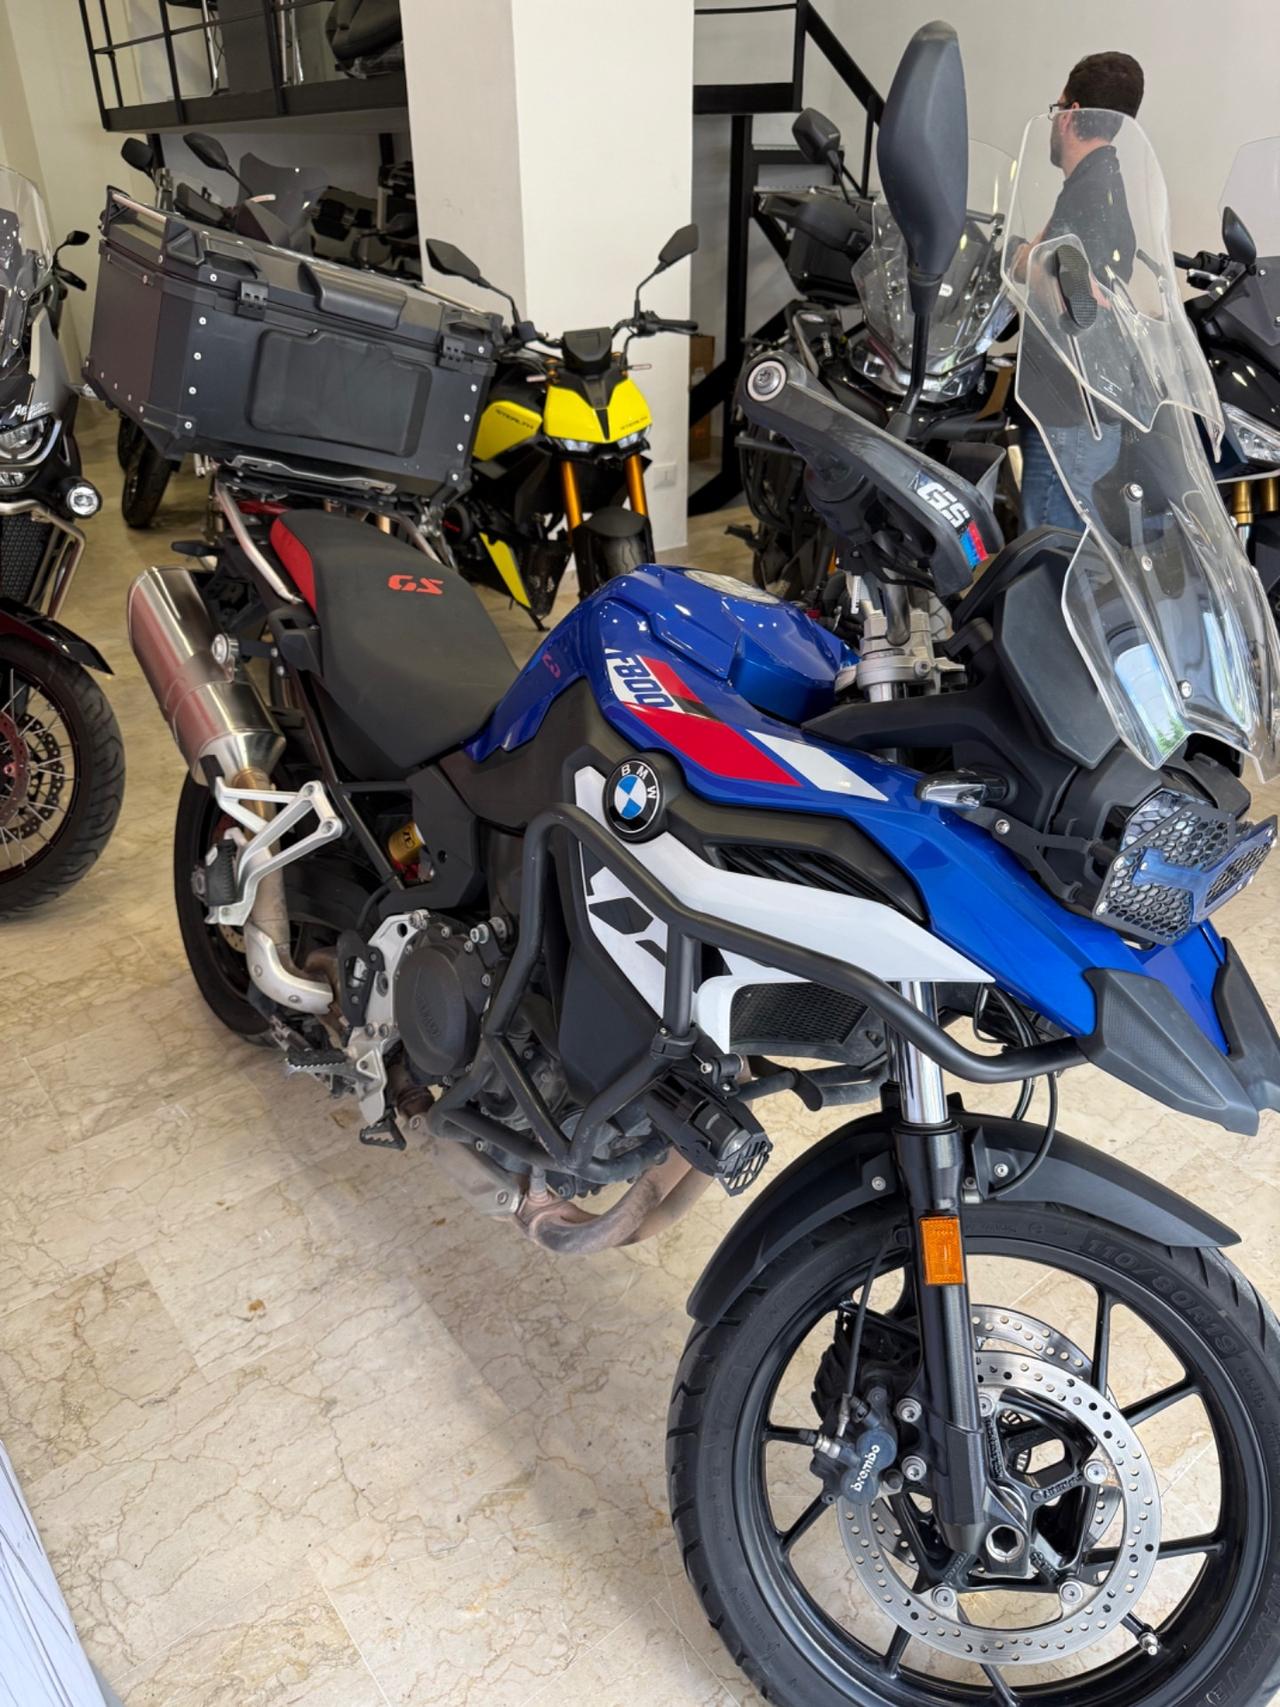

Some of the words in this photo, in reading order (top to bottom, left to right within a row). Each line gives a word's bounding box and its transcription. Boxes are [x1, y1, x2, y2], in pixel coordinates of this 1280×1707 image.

[917, 482, 971, 528] GS
[388, 574, 444, 595] GS
[621, 763, 657, 800] BMW
[850, 1444, 880, 1492] brembo
